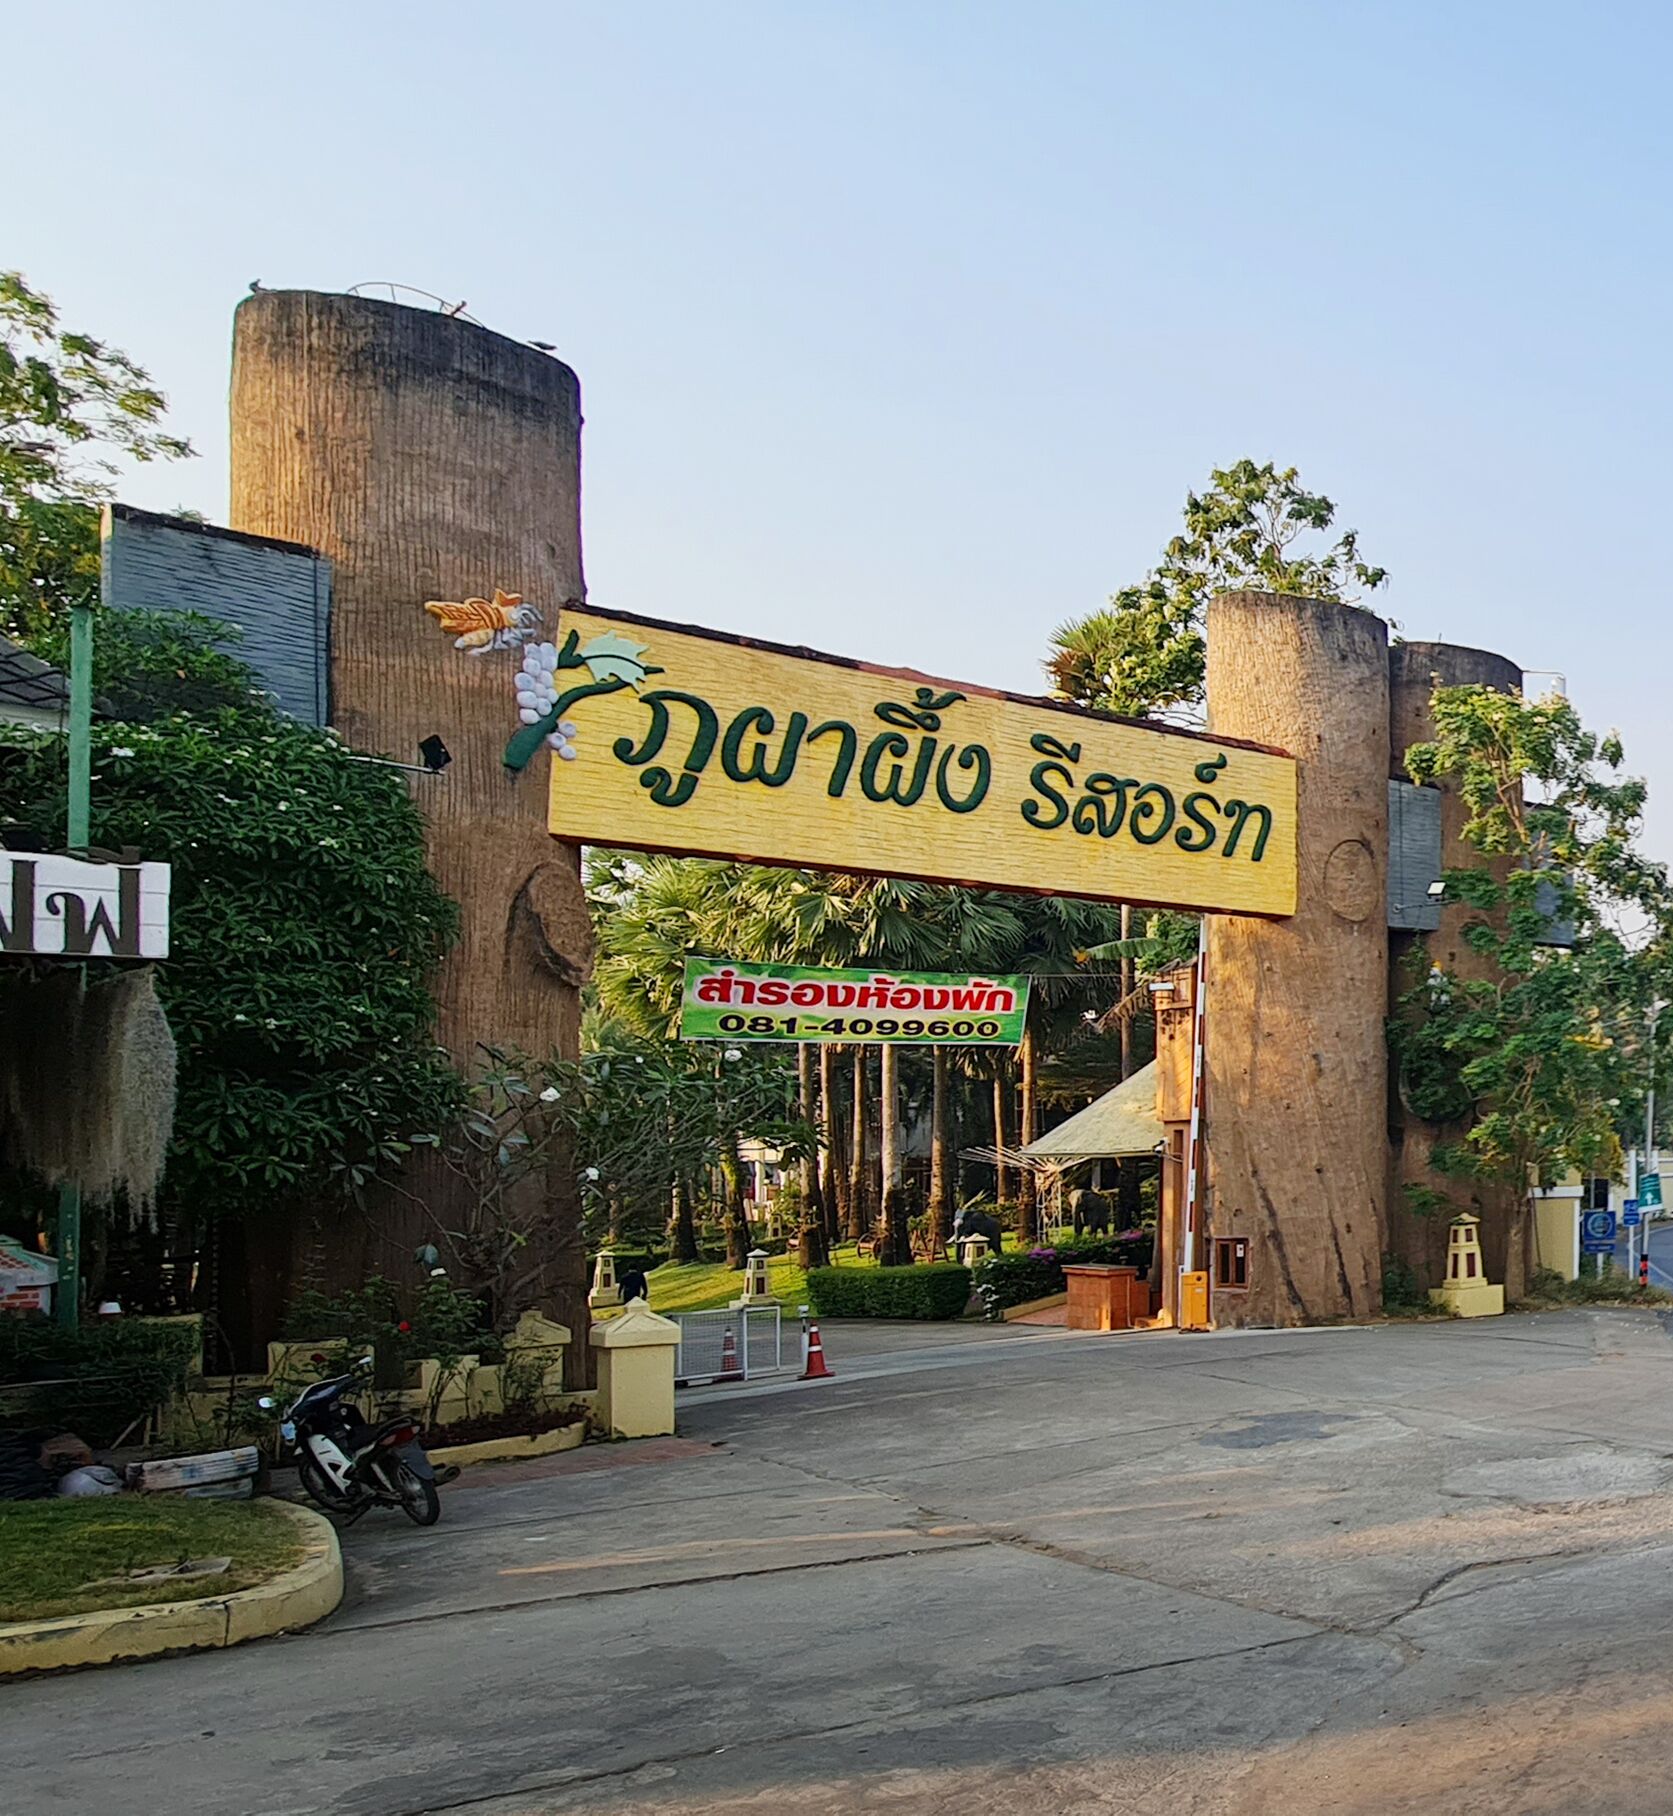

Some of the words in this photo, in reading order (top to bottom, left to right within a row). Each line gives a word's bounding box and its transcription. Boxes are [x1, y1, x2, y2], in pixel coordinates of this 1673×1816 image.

[612, 686, 992, 814] ภูผาผึ้ง
[1020, 732, 1273, 863] รีสอร์ท
[697, 969, 1014, 1012] สำรองห้องพัก
[718, 1013, 1000, 1038] 081-4099600
